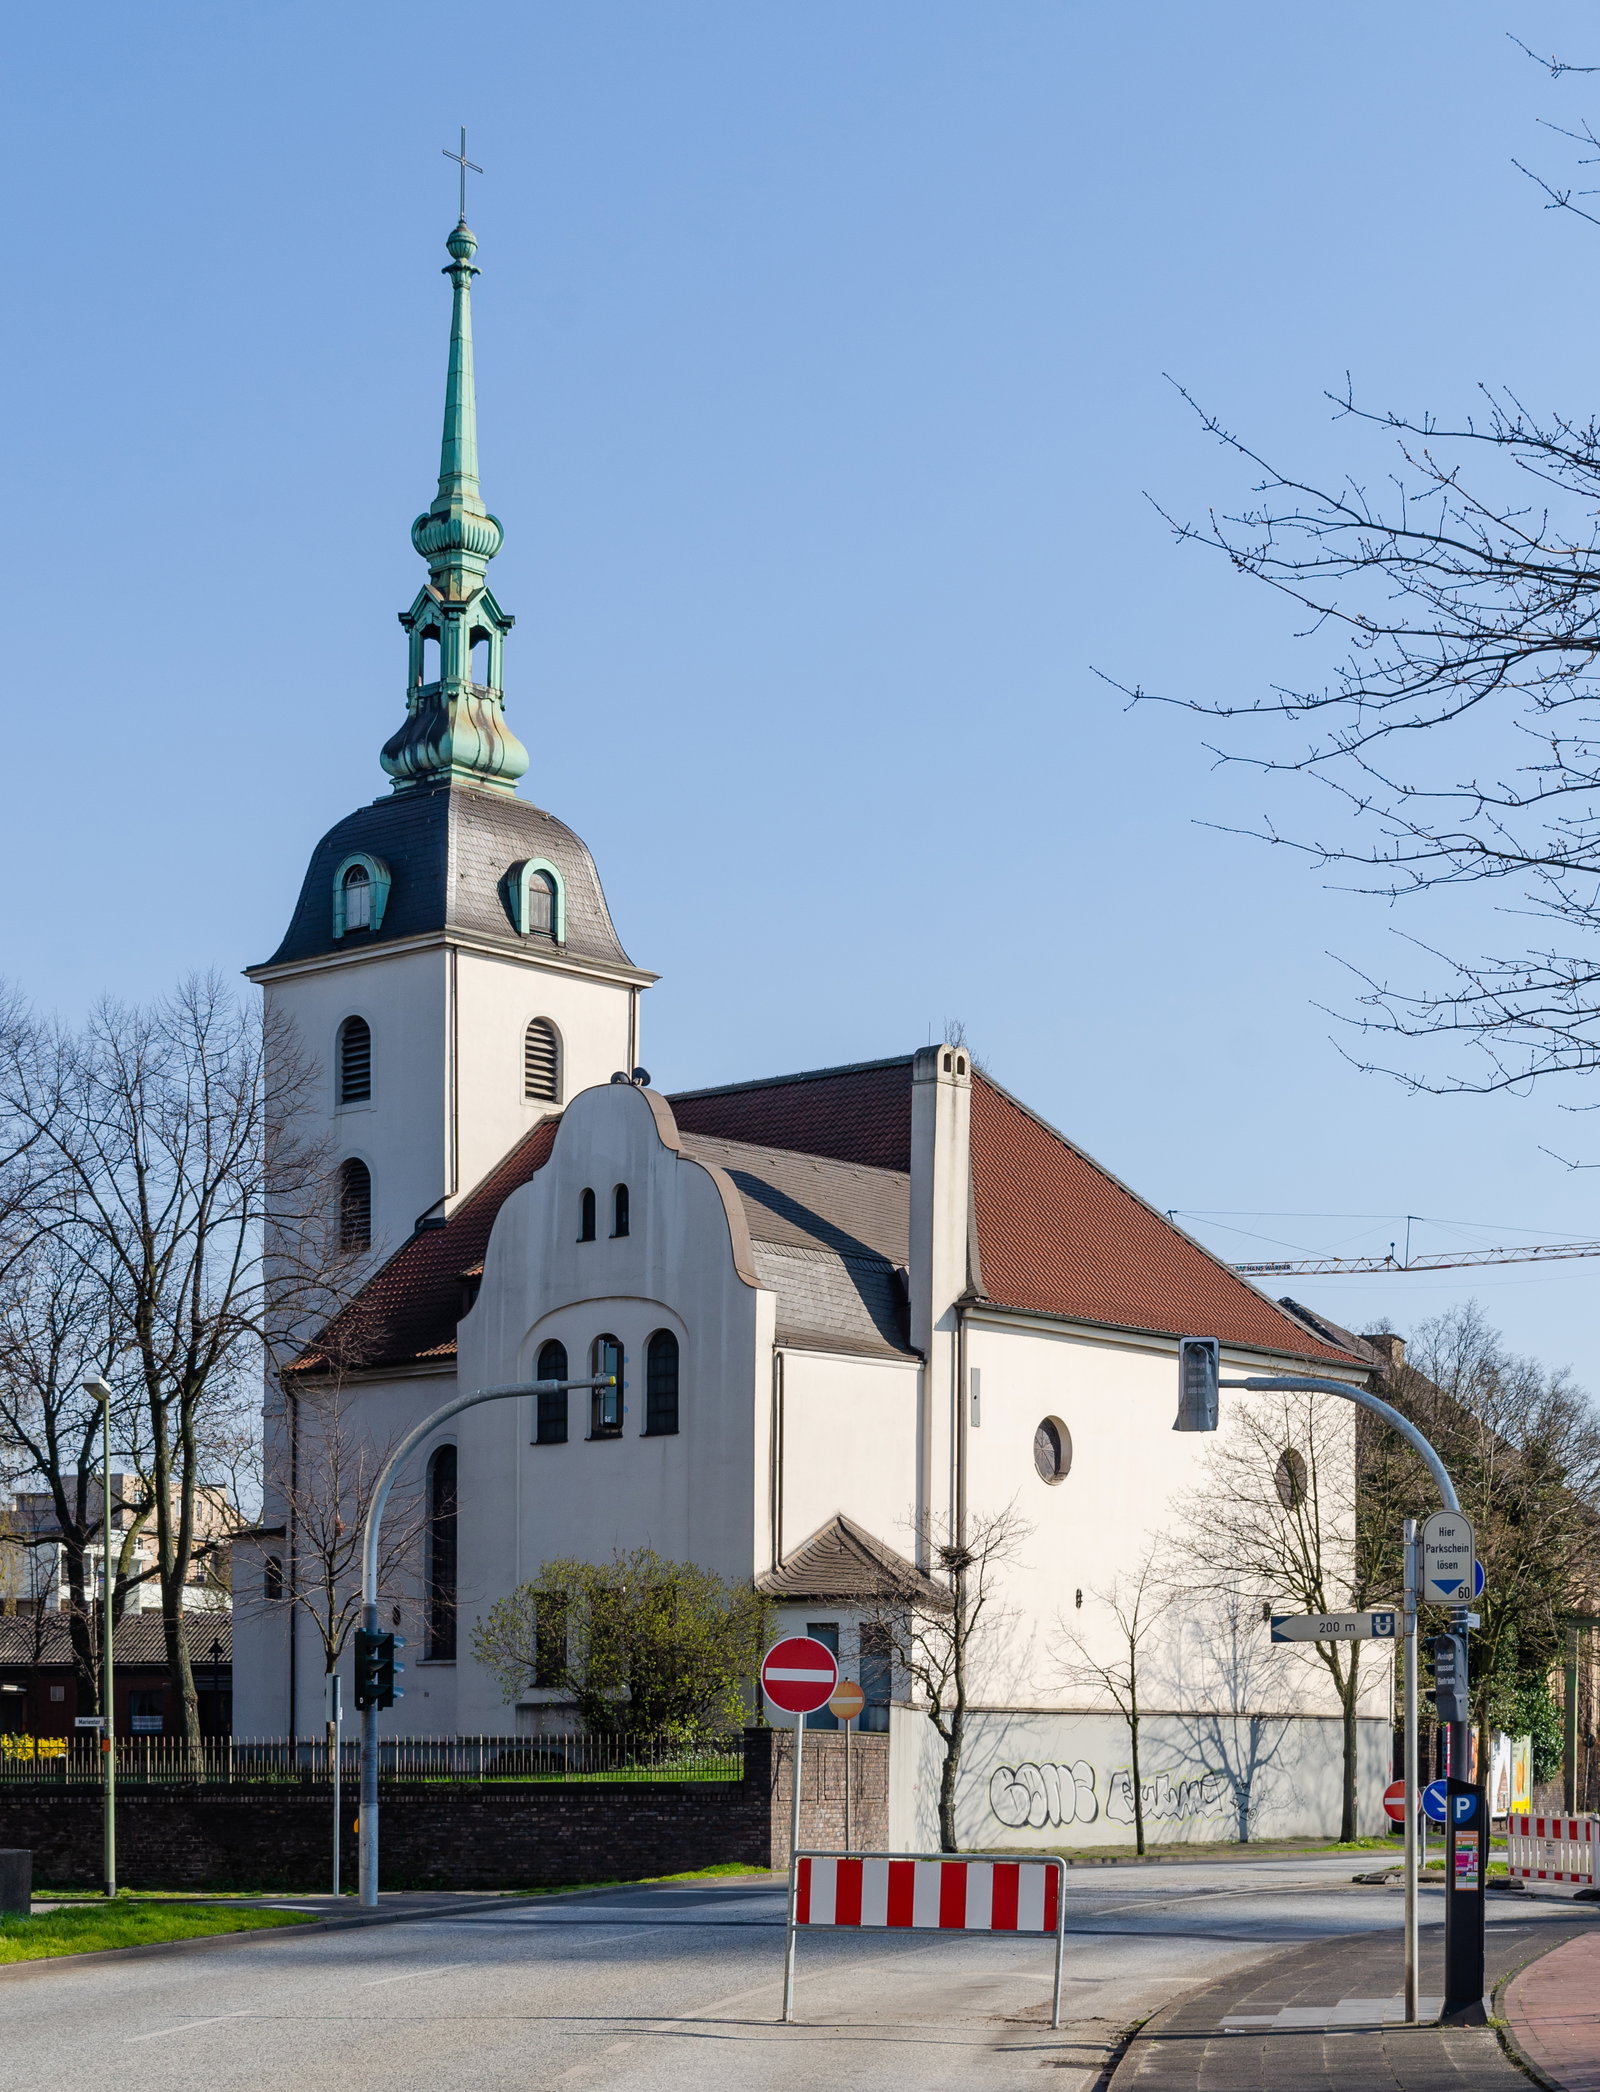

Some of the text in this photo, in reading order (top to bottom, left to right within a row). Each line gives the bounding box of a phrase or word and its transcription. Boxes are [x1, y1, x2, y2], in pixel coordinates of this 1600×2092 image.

[1439, 1527, 1455, 1537] Hier
[1426, 1543, 1469, 1553] Parkschein
[1437, 1560, 1458, 1570] lösen
[1458, 1586, 1470, 1599] 60
[1319, 1622, 1340, 1633] 200
[1345, 1623, 1356, 1632] m
[1456, 1797, 1470, 1818] P
